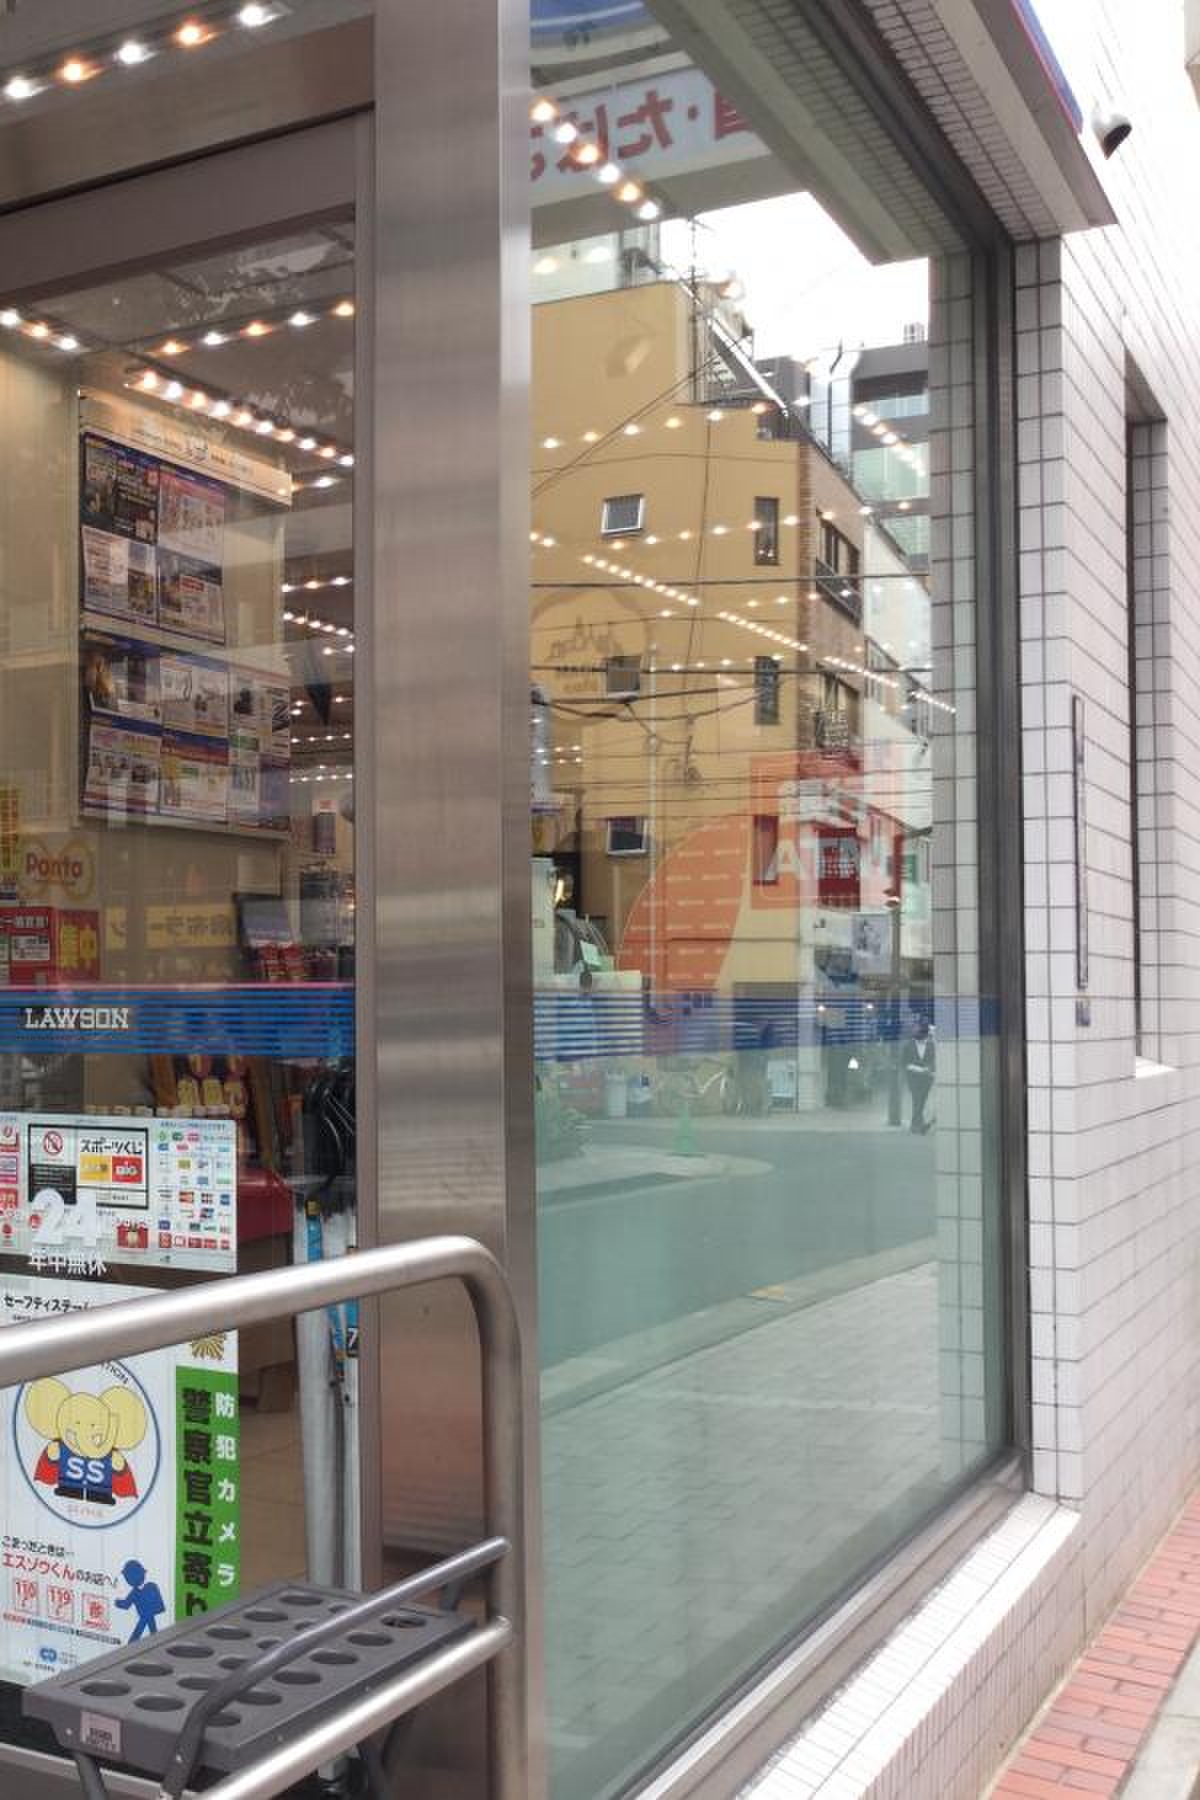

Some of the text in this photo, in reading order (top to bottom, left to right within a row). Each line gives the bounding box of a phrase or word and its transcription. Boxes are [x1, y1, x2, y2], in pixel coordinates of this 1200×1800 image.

[24, 1007, 130, 1030] LAWSON
[80, 1137, 144, 1156] スポーツくじ
[3, 1293, 89, 1314] セーフティステー
[214, 1391, 237, 1588] 防犯カメラ
